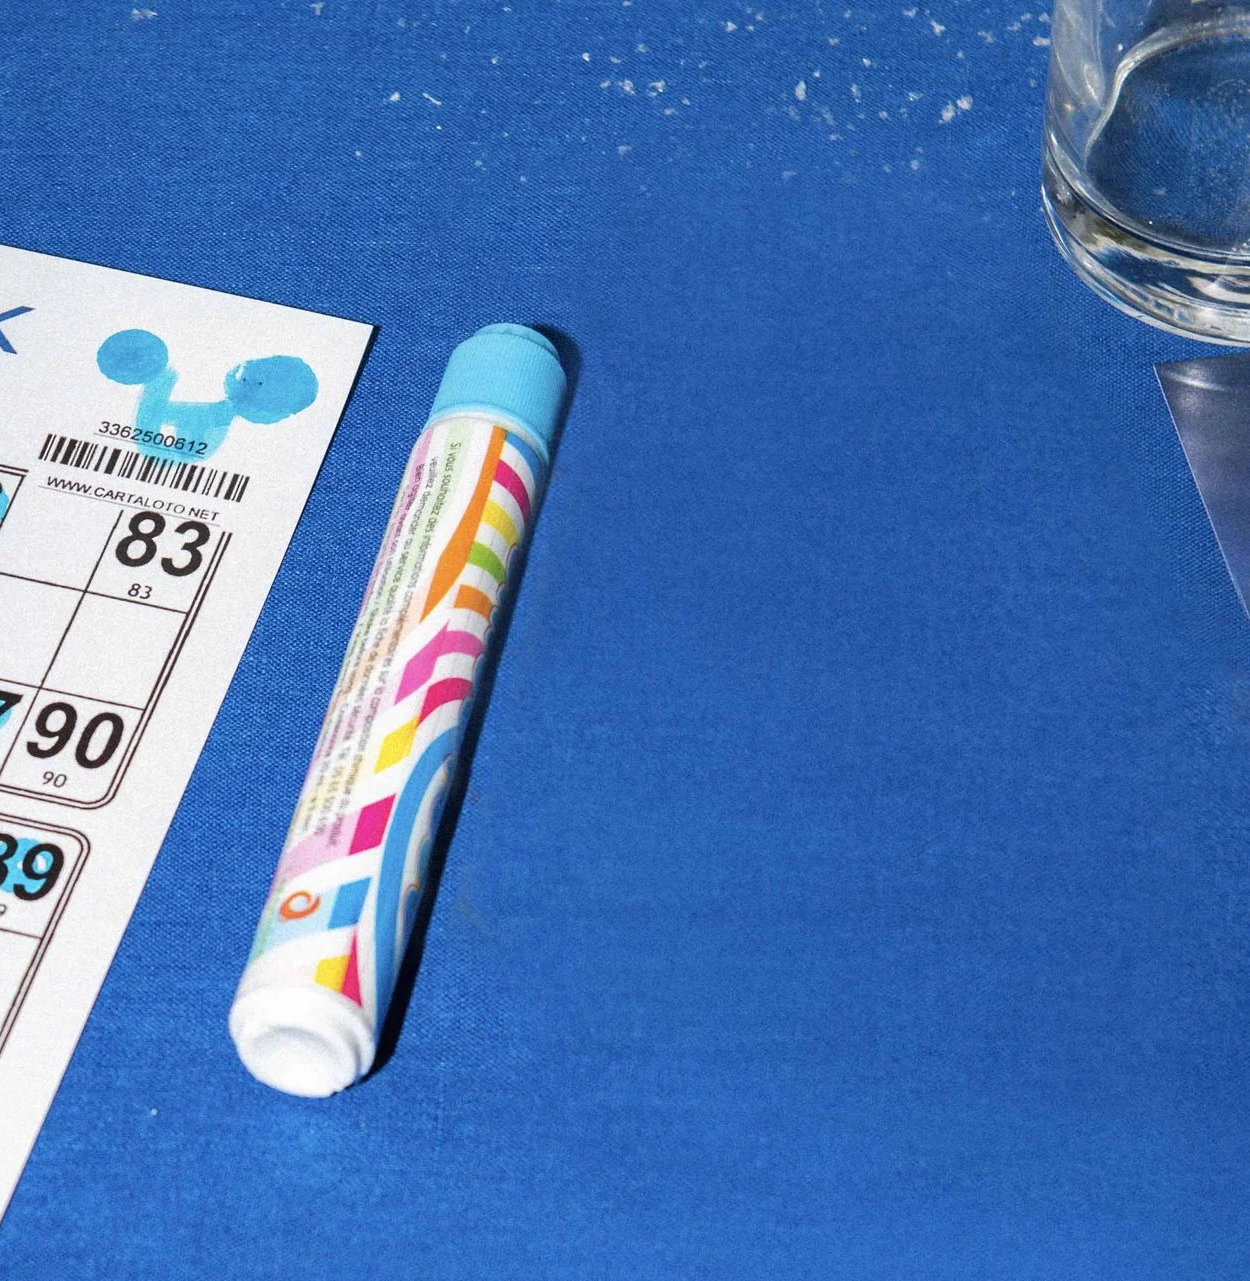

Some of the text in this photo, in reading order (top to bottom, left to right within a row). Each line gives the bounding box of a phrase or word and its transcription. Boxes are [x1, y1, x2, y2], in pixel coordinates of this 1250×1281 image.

[98, 420, 209, 456] 3362500612
[449, 440, 462, 450] Si
[411, 462, 426, 484] Bien
[422, 455, 442, 489] veuillez
[443, 451, 460, 473] vous
[402, 482, 420, 511] agiter
[430, 473, 453, 517] souhaitez
[393, 512, 407, 538] avant
[408, 489, 431, 536] demander
[424, 516, 439, 534] des
[115, 510, 211, 577] 83
[403, 537, 413, 550] au
[392, 549, 410, 584] service
[406, 534, 433, 589] informations
[126, 582, 153, 600] 83
[26, 701, 125, 770] 90
[41, 770, 68, 789] 90
